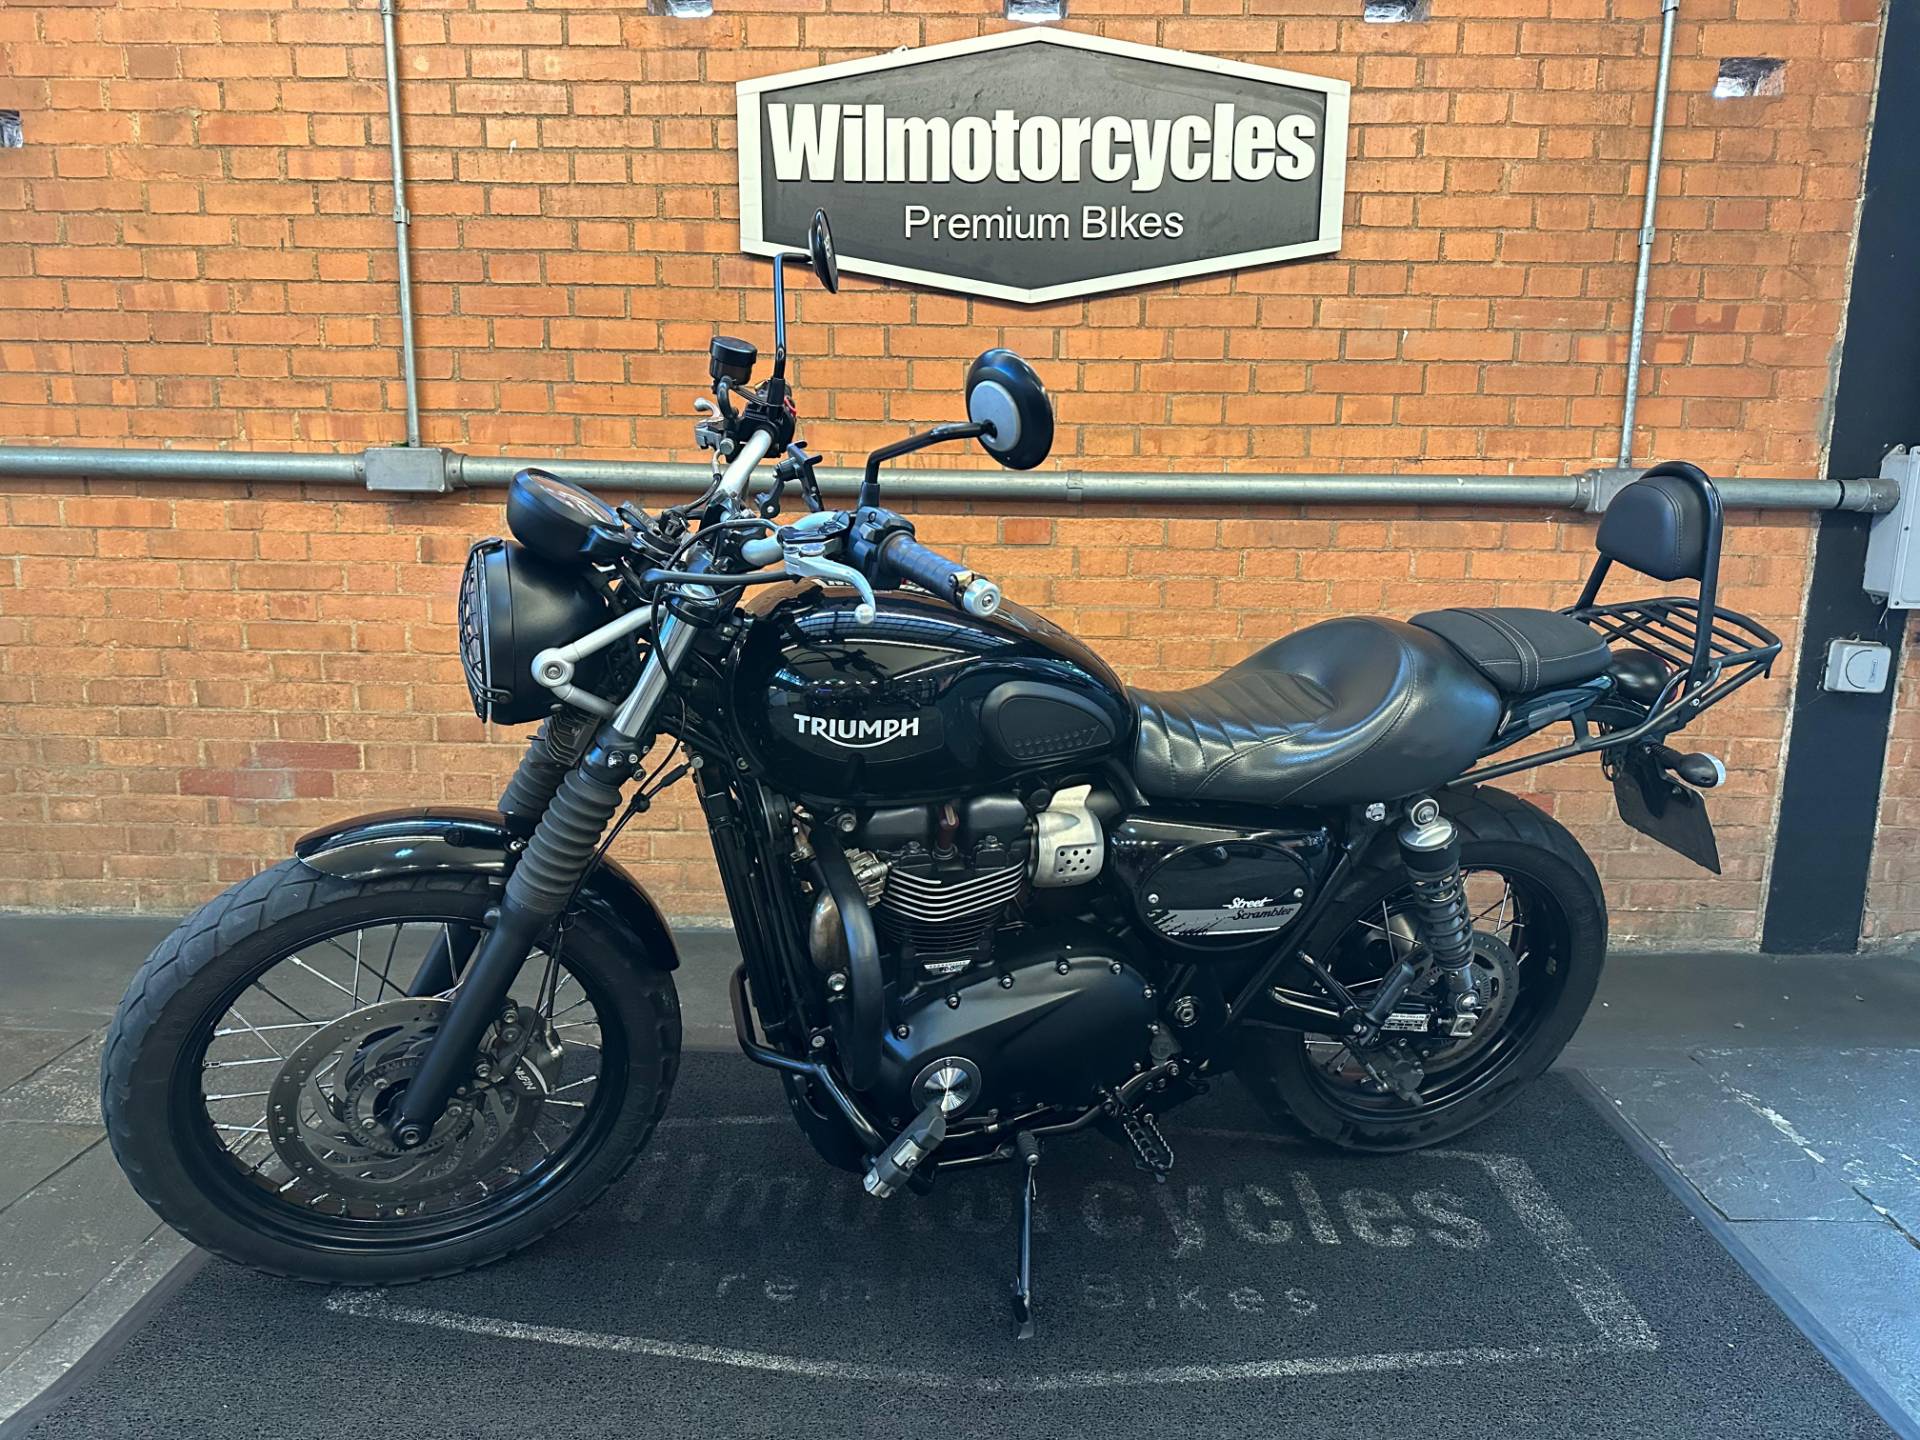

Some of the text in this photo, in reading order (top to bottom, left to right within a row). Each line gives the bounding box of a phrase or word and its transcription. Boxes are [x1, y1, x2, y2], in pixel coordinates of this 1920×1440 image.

[766, 102, 1317, 192] Wilmotorcycles
[904, 205, 1070, 240] Premium
[793, 712, 920, 747] TRIUMPH
[1222, 896, 1274, 910] Street
[1229, 906, 1295, 921] Scrambler
